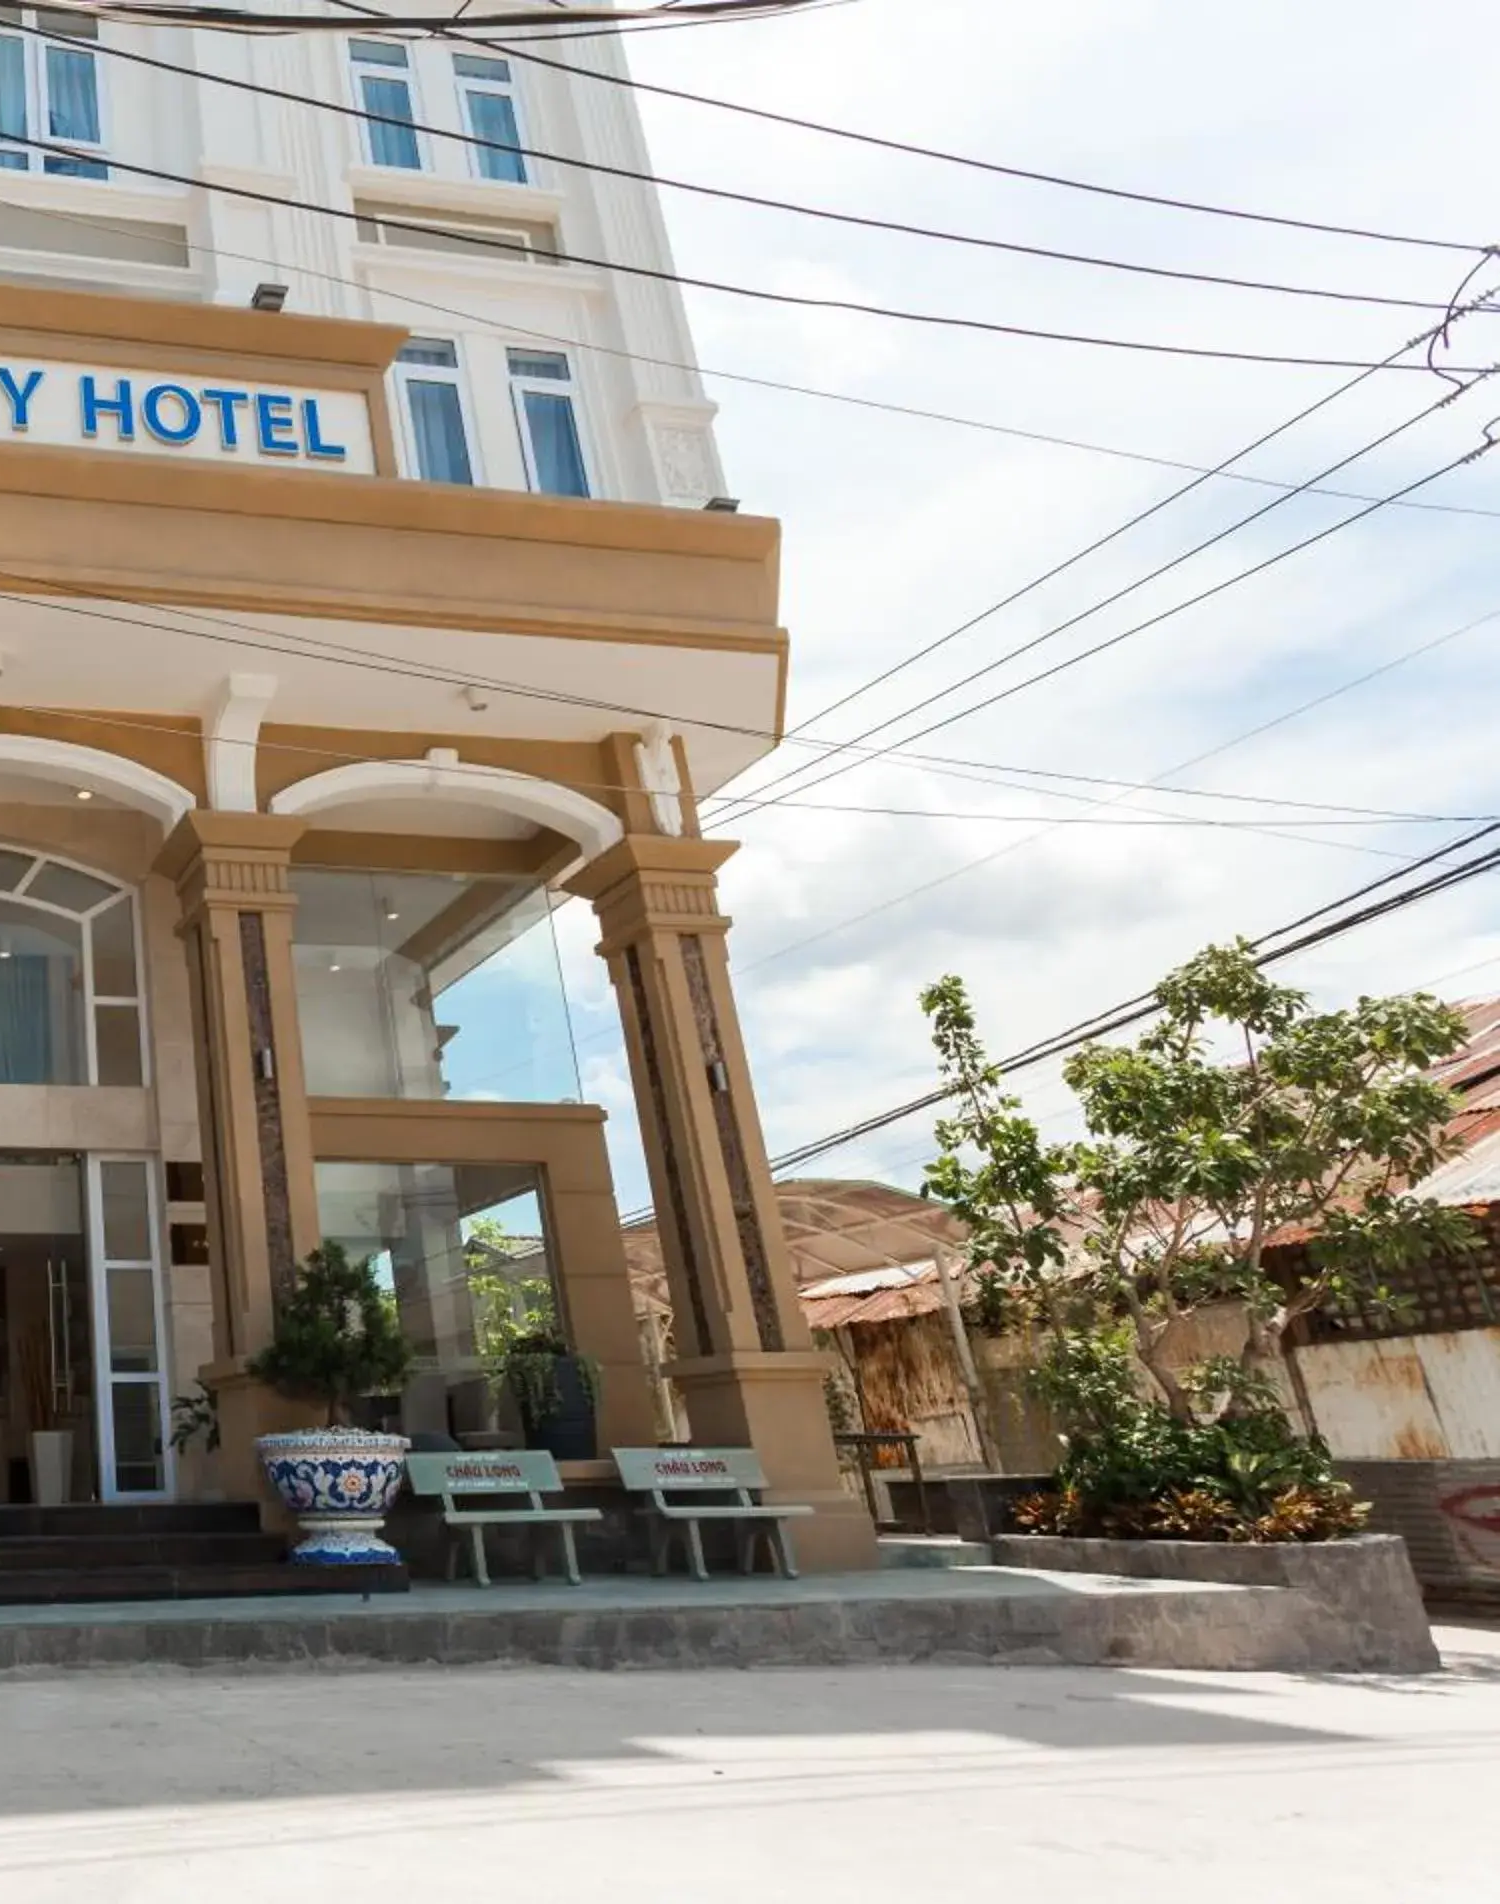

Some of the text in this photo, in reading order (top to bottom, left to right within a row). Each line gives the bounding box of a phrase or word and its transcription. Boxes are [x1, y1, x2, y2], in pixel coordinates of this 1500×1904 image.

[81, 377, 346, 459] HOTEL
[486, 1462, 521, 1477] LONG
[694, 1460, 728, 1474] LONG
